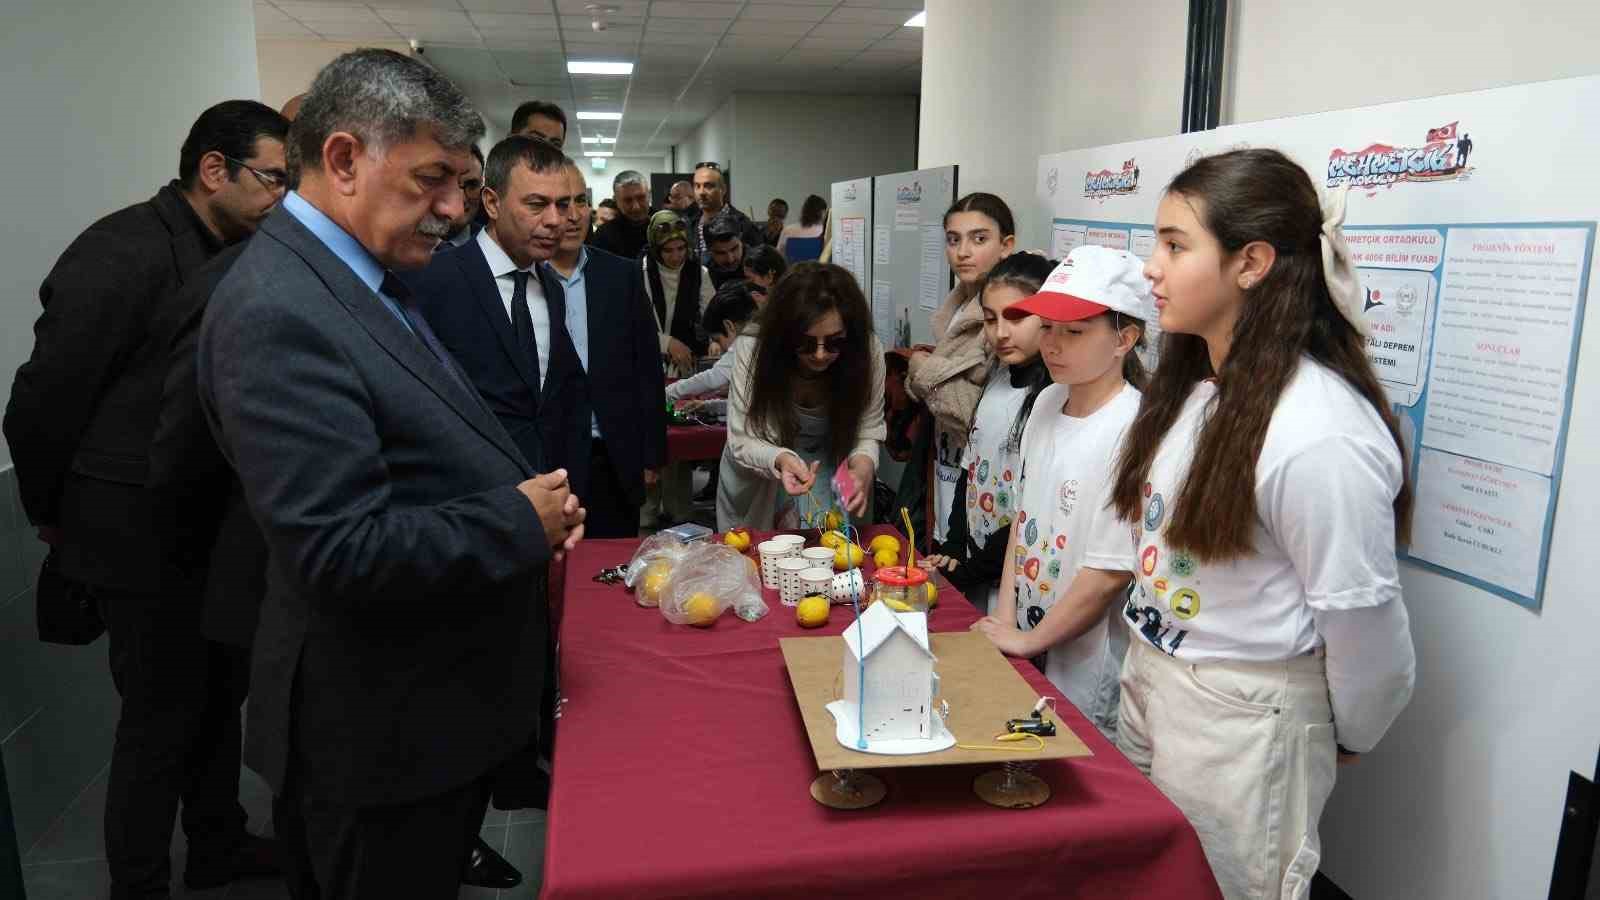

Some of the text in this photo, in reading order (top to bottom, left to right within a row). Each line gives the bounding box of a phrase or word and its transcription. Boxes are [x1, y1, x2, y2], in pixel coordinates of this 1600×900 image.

[1382, 234, 1437, 245] ORTAOKULU
[1411, 254, 1438, 264] FUARI
[1383, 341, 1415, 352] DEPREM
